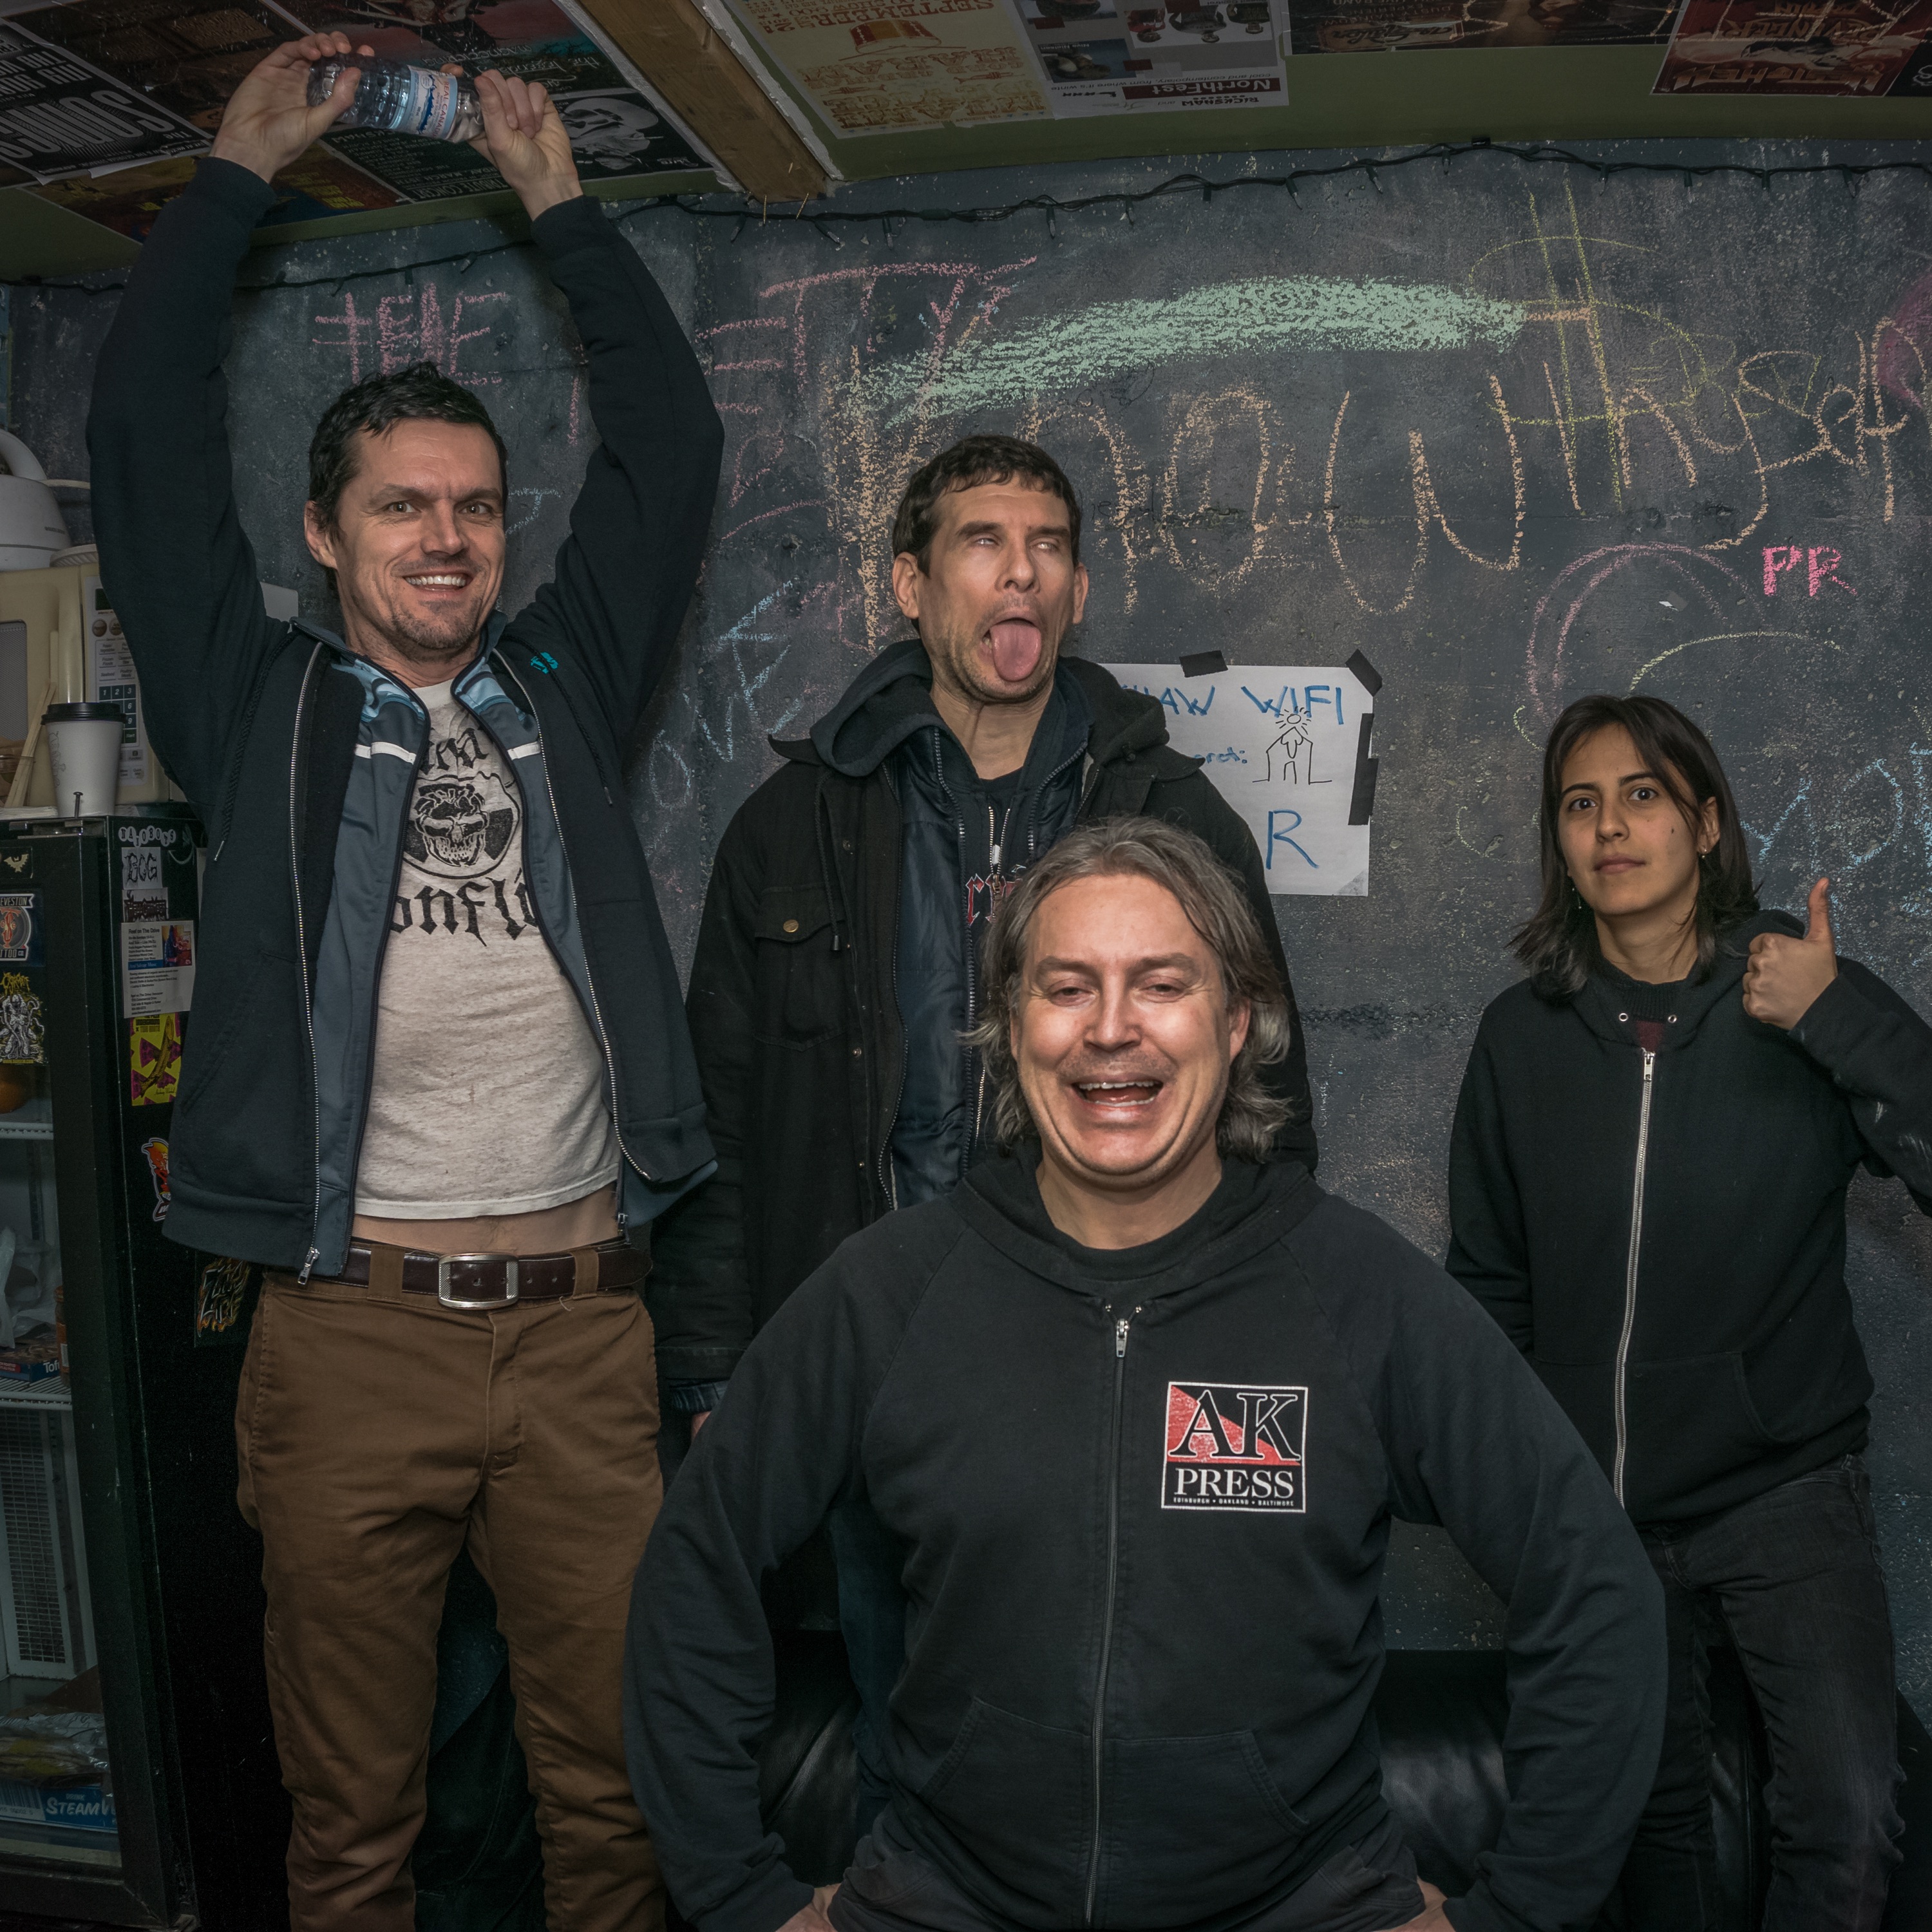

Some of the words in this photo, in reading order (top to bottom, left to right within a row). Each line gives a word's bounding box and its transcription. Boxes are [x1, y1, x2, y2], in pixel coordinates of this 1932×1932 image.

[762, 23, 795, 34] 21
[797, 46, 1021, 83] HARAM
[441, 81, 450, 104] REAL
[1150, 79, 1271, 95] NorthFest
[1181, 97, 1259, 107] RICKSHAW
[833, 95, 1046, 129] MIAMI
[163, 131, 193, 141] The
[462, 178, 507, 194] TRIBUTE
[1762, 544, 1858, 598] PR
[1240, 685, 1344, 725] WIFI
[1265, 809, 1320, 869] R
[1168, 1389, 1302, 1461] AK
[1173, 1468, 1294, 1499] PRESS
